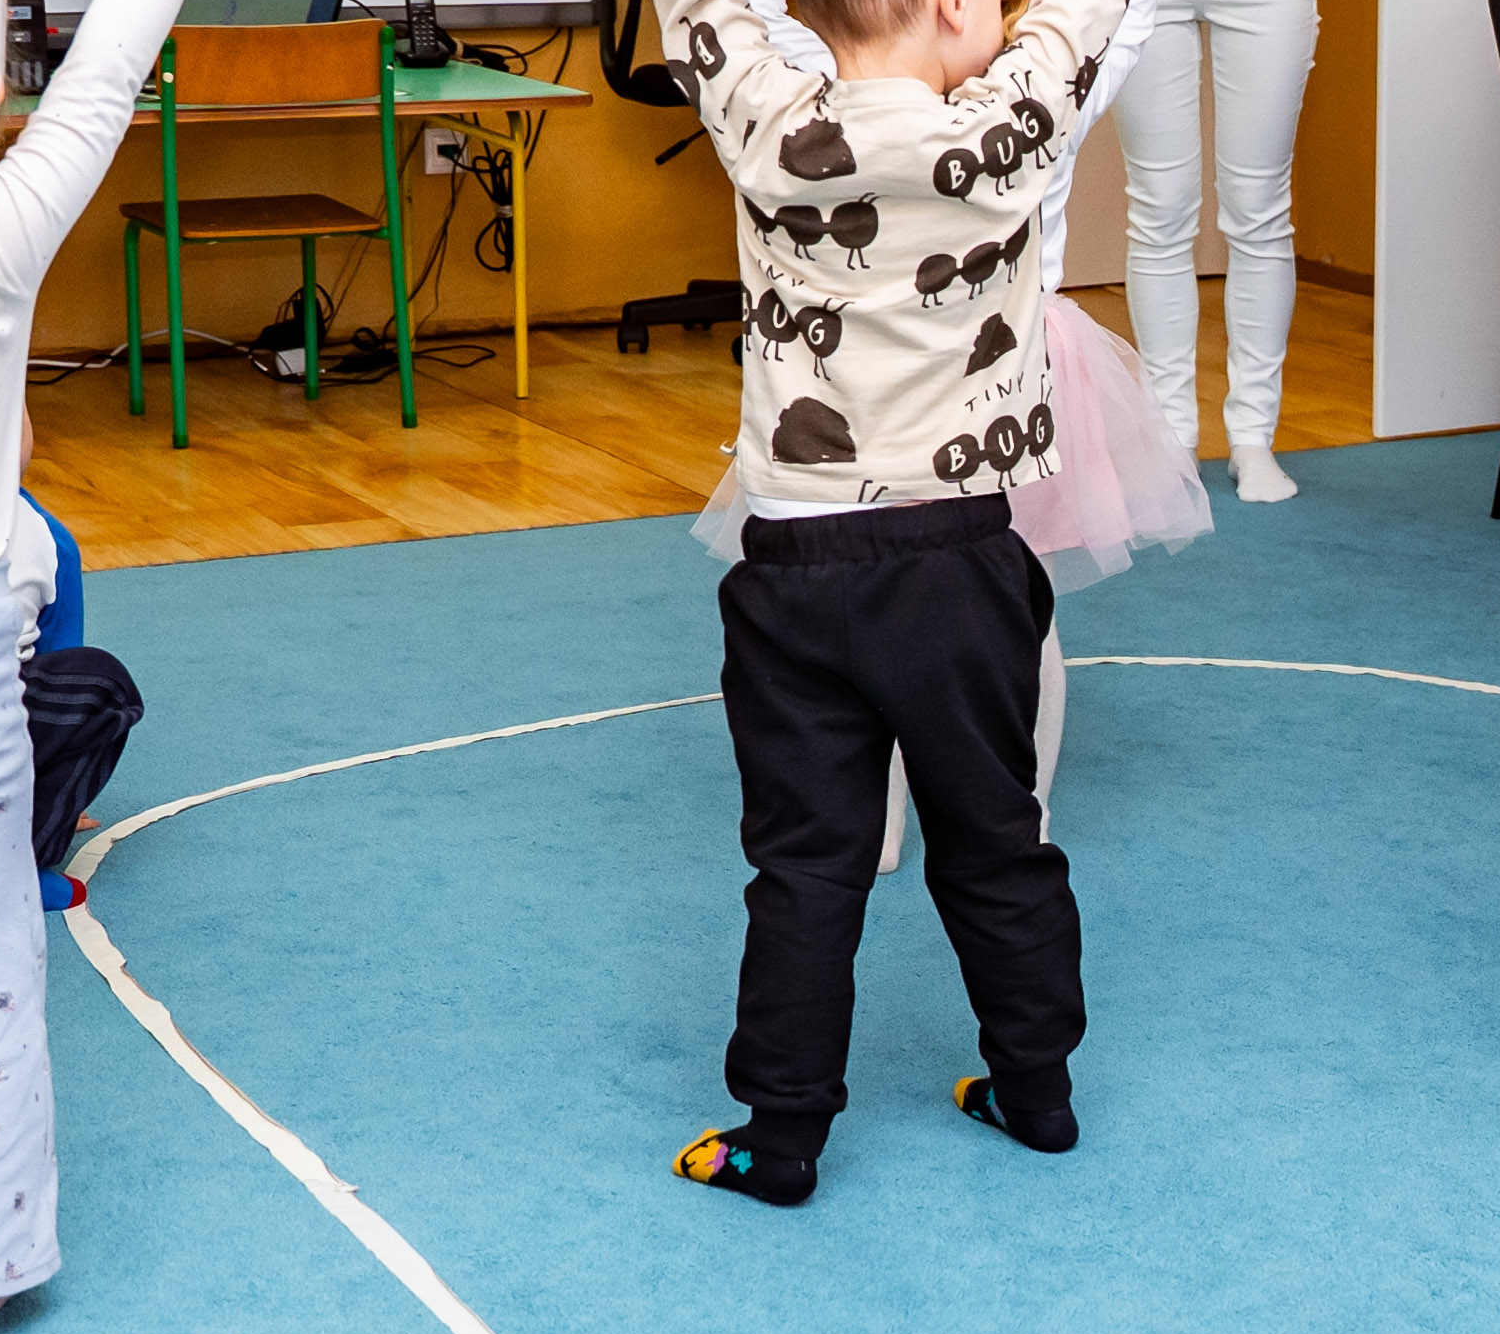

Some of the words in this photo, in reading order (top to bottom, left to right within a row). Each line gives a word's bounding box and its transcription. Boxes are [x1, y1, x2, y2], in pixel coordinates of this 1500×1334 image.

[948, 110, 1039, 190] BUG
[964, 371, 1025, 413] TINY
[947, 416, 1045, 473] BUG
